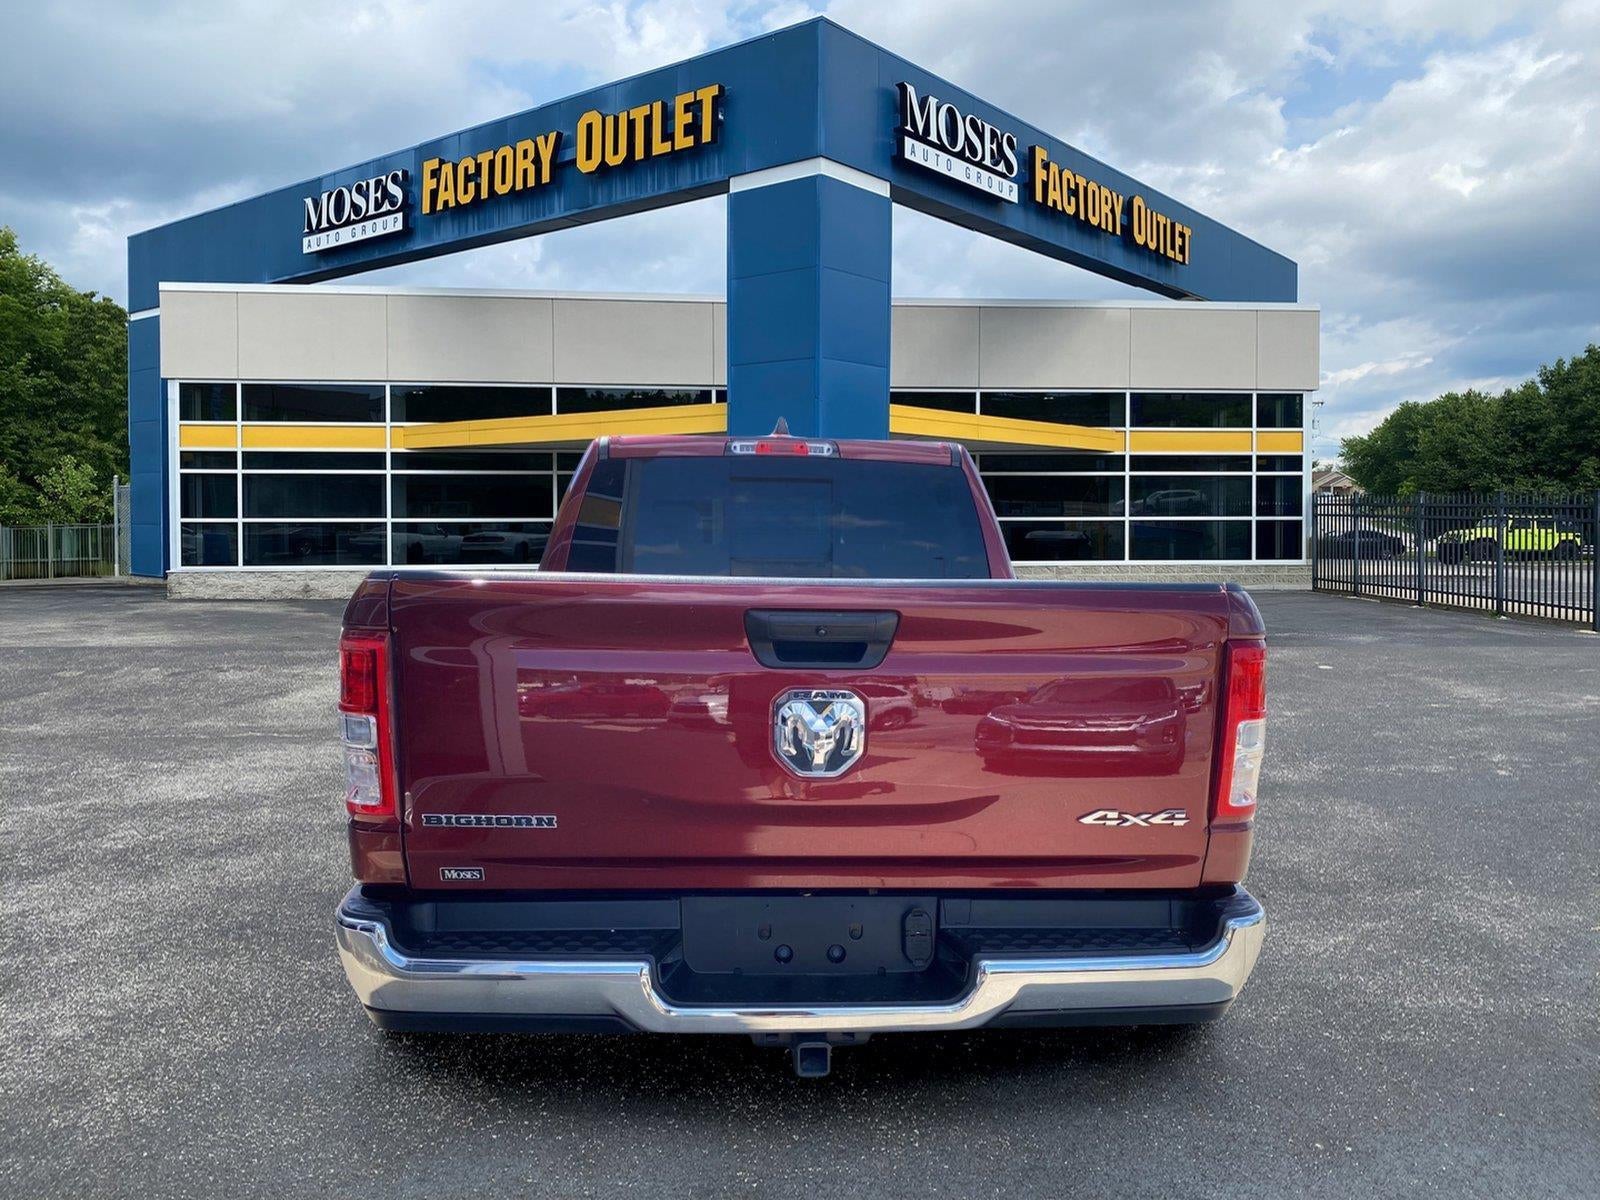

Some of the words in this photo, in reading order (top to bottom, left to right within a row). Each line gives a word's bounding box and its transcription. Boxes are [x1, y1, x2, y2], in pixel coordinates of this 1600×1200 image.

[422, 130, 562, 215] FACTORY
[575, 83, 724, 175] OUTLET
[904, 82, 1018, 178] MOSES
[909, 143, 952, 172] AUTO
[965, 166, 1014, 197] GROUP
[303, 169, 404, 234] MOSES
[1034, 145, 1124, 236] FACTORY
[1132, 195, 1192, 265] OUTLET
[306, 231, 341, 250] AUTO
[351, 216, 400, 239] GROUP
[793, 691, 848, 700] RAM
[422, 813, 557, 828] BIGHORN
[1077, 808, 1190, 827] 4x4
[444, 869, 480, 880] MOSES
